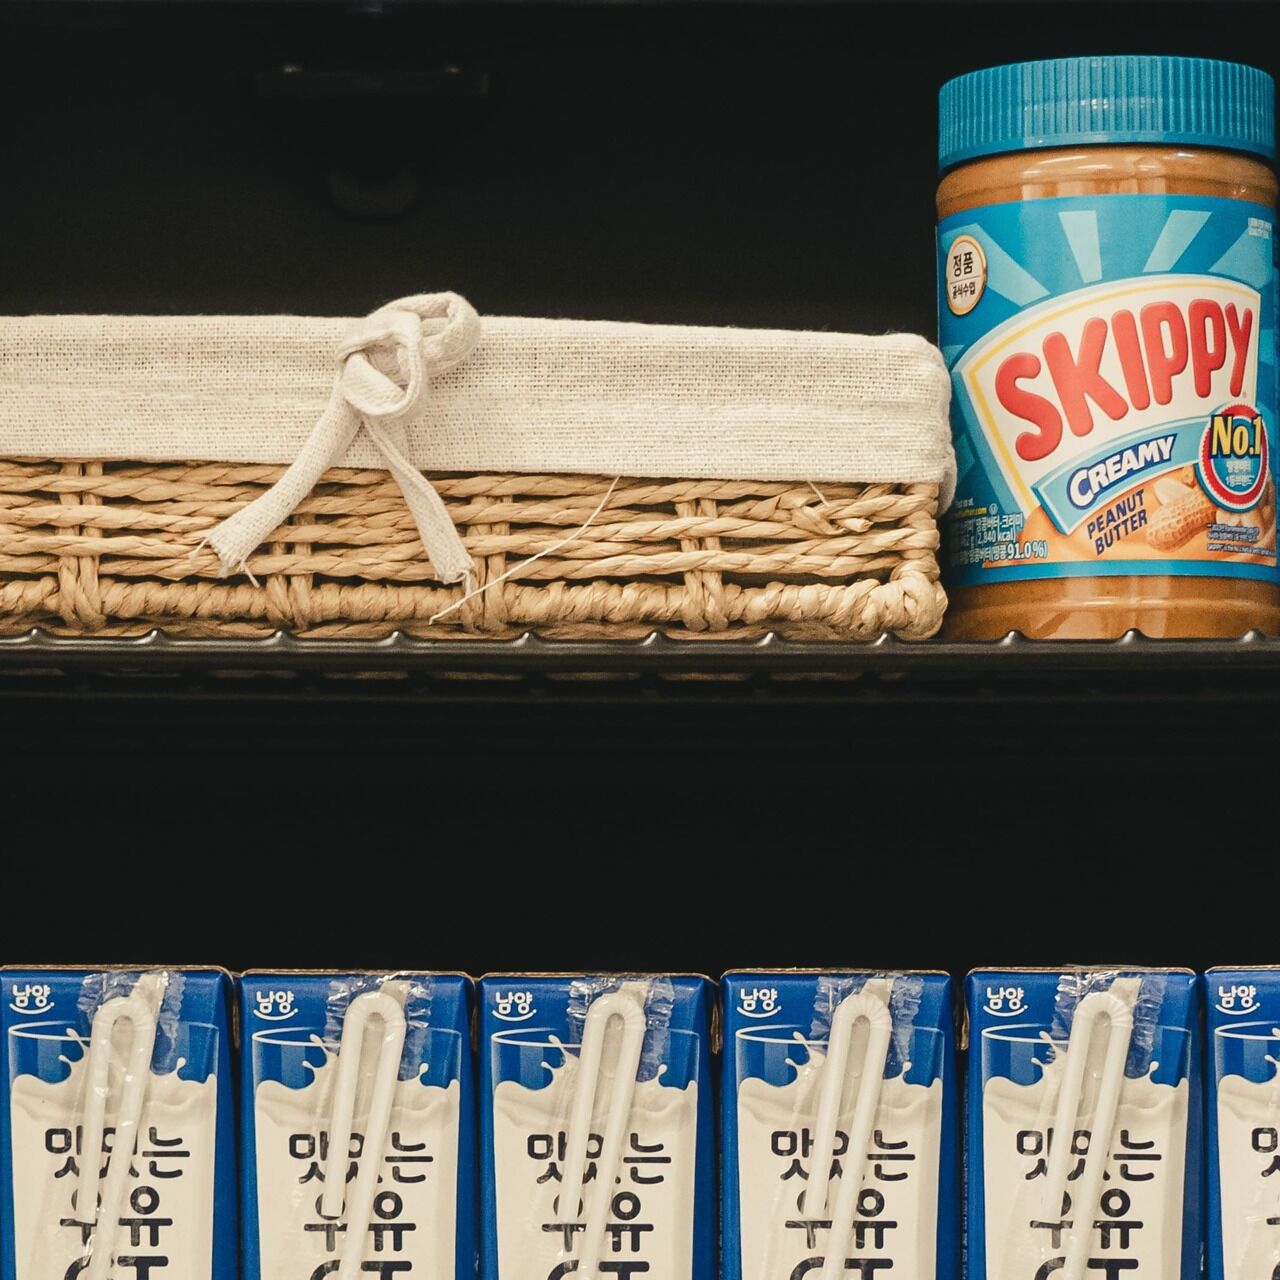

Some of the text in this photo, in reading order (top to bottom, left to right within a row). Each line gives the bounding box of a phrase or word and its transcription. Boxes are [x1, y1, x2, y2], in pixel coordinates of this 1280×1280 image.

[953, 252, 974, 277] 정품
[953, 281, 976, 299] 공식수입
[995, 299, 1253, 462] SKIPPY
[1211, 415, 1262, 457] No.1
[1068, 434, 1176, 508] CREAMY
[1087, 489, 1144, 539] PEANUT
[1095, 509, 1148, 555] BUTTER
[13, 985, 50, 1007] 남양
[256, 991, 294, 1013] 남양
[495, 991, 532, 1014] 남양
[740, 989, 777, 1010] 남양
[987, 987, 1024, 1010] 남양
[1219, 985, 1256, 1008] 남양
